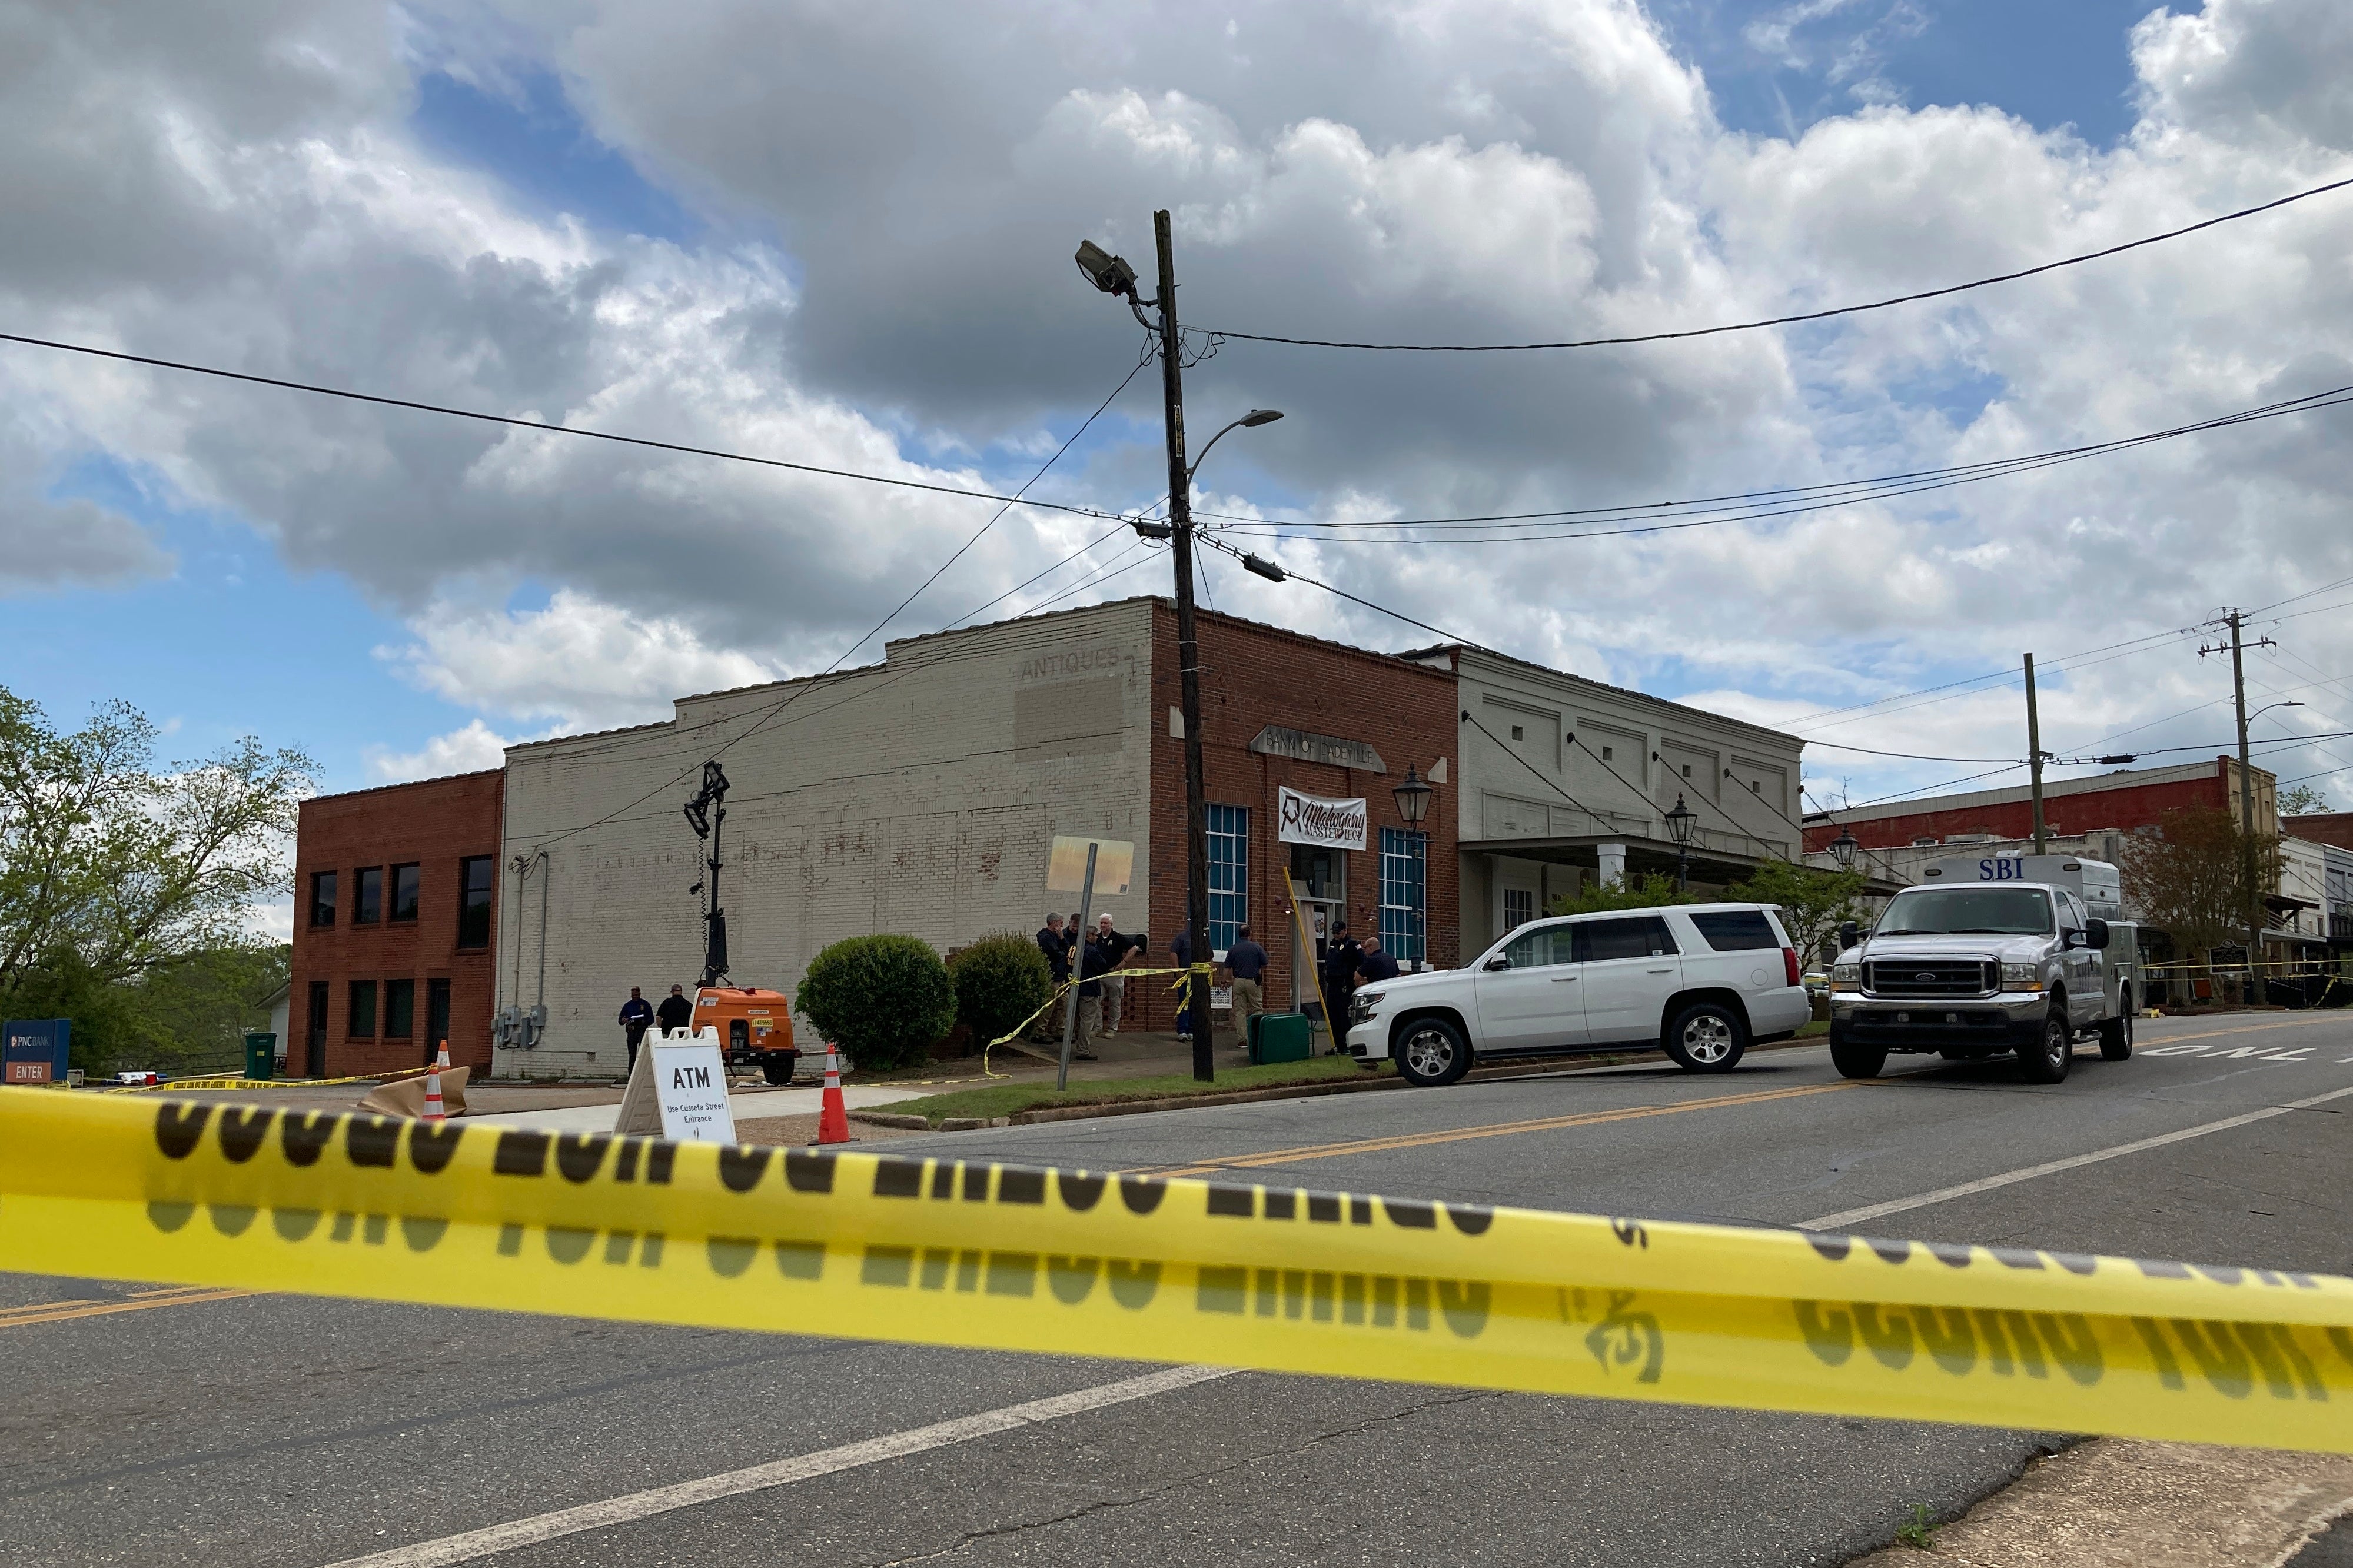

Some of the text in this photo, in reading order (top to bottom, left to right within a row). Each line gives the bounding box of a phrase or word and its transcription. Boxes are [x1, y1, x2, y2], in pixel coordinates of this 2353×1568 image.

[1021, 648, 1119, 680] ANTIQUES
[1266, 733, 1373, 764] BANK OF DADEVILLE
[1302, 800, 1365, 838] Mahogany
[1979, 857, 2025, 881] SBI
[2138, 1045, 2353, 1063] ONL
[16, 1065, 43, 1079] ENTER
[673, 1067, 710, 1089] ATM
[667, 1101, 724, 1113] Use Cusseta Street
[684, 1114, 712, 1123] Entrance
